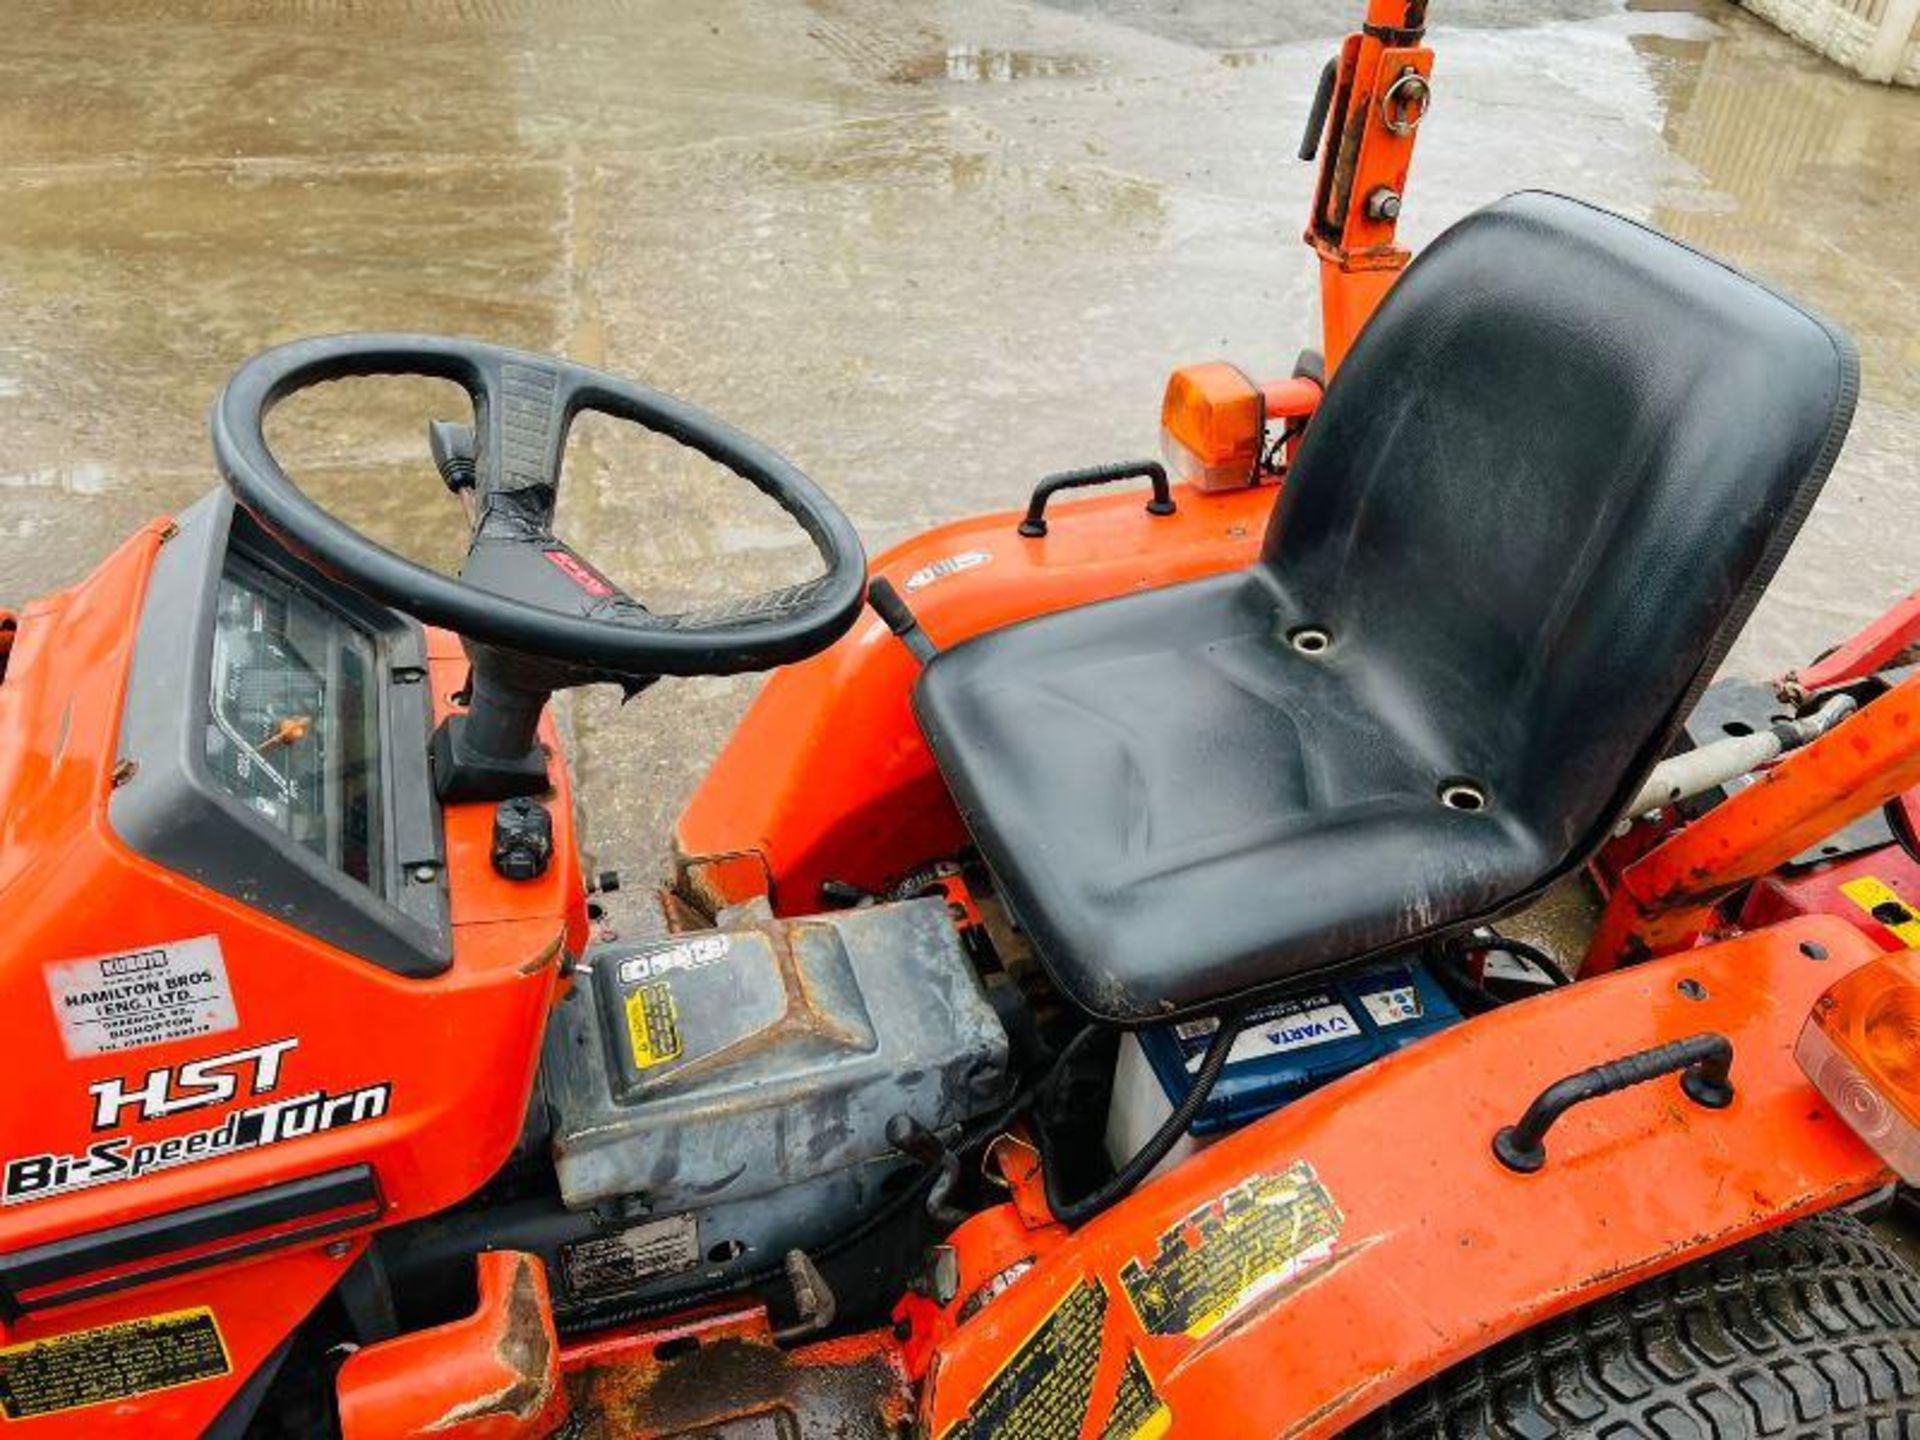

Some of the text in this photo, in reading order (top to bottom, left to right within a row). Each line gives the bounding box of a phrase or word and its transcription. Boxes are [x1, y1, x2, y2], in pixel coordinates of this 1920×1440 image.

[65, 982, 160, 1007] HAMILTON
[165, 971, 217, 990] BROS.
[159, 990, 195, 1005] LTD.
[1267, 1020, 1325, 1045] VARTA
[88, 1036, 299, 1132] HST
[4, 1112, 238, 1199] Bi-Speed
